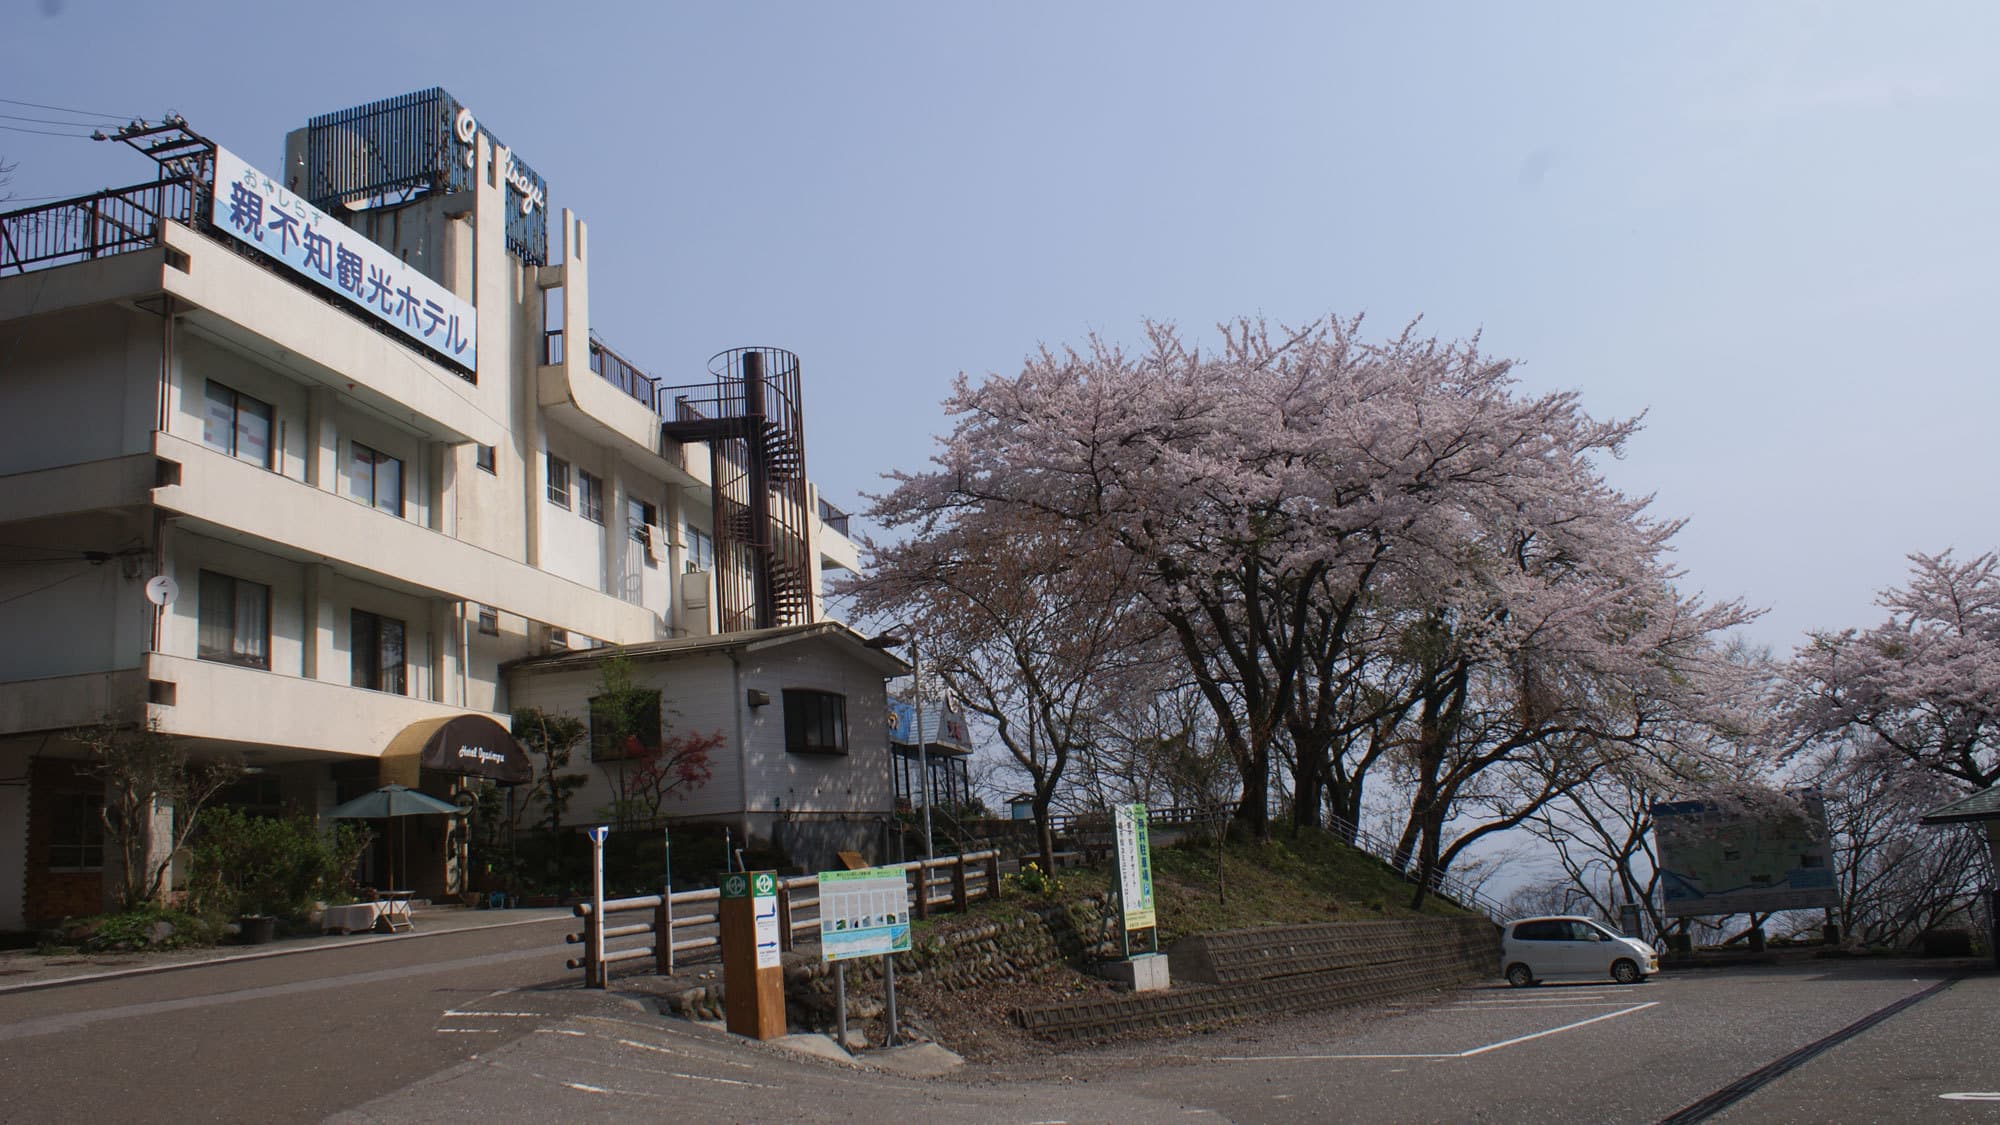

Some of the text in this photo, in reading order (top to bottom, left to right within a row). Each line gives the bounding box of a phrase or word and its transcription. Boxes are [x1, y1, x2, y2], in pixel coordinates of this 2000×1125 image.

[242, 168, 323, 227] おやしらず
[229, 180, 468, 355] 親不知観光ホテル
